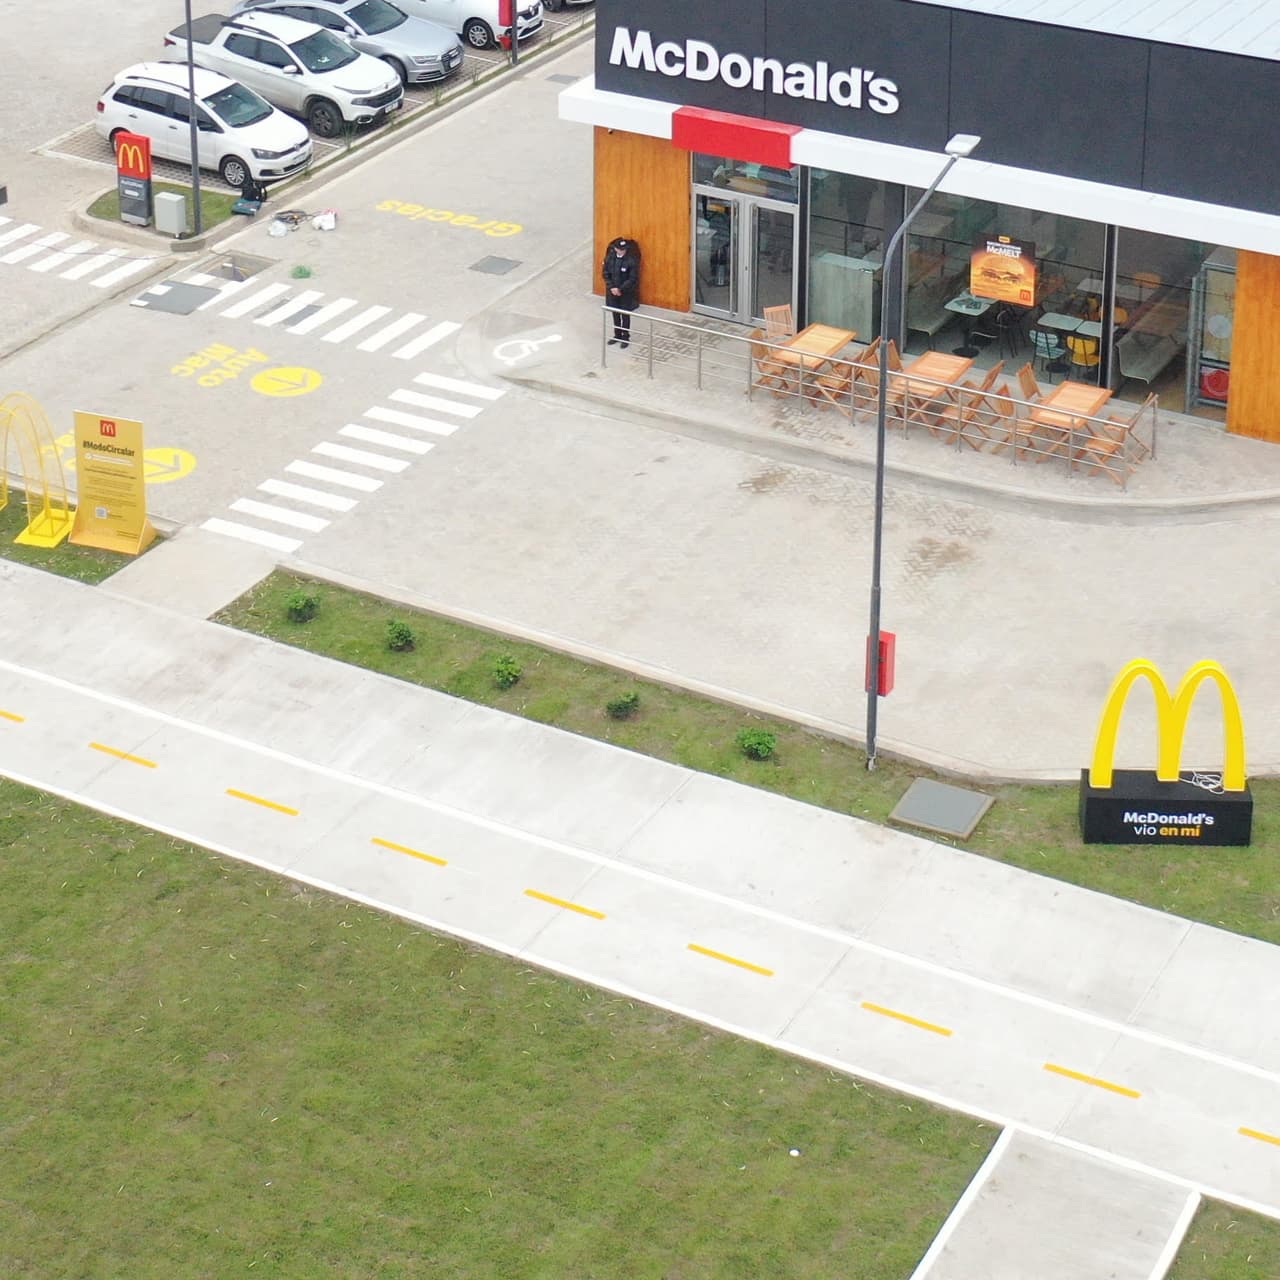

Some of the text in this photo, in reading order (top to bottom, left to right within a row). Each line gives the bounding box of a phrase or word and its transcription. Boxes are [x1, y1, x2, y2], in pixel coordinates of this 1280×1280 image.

[609, 26, 900, 115] McDonald's
[1123, 812, 1215, 825] McDonald's
[1134, 824, 1157, 836] vio
[1159, 826, 1179, 836] en
